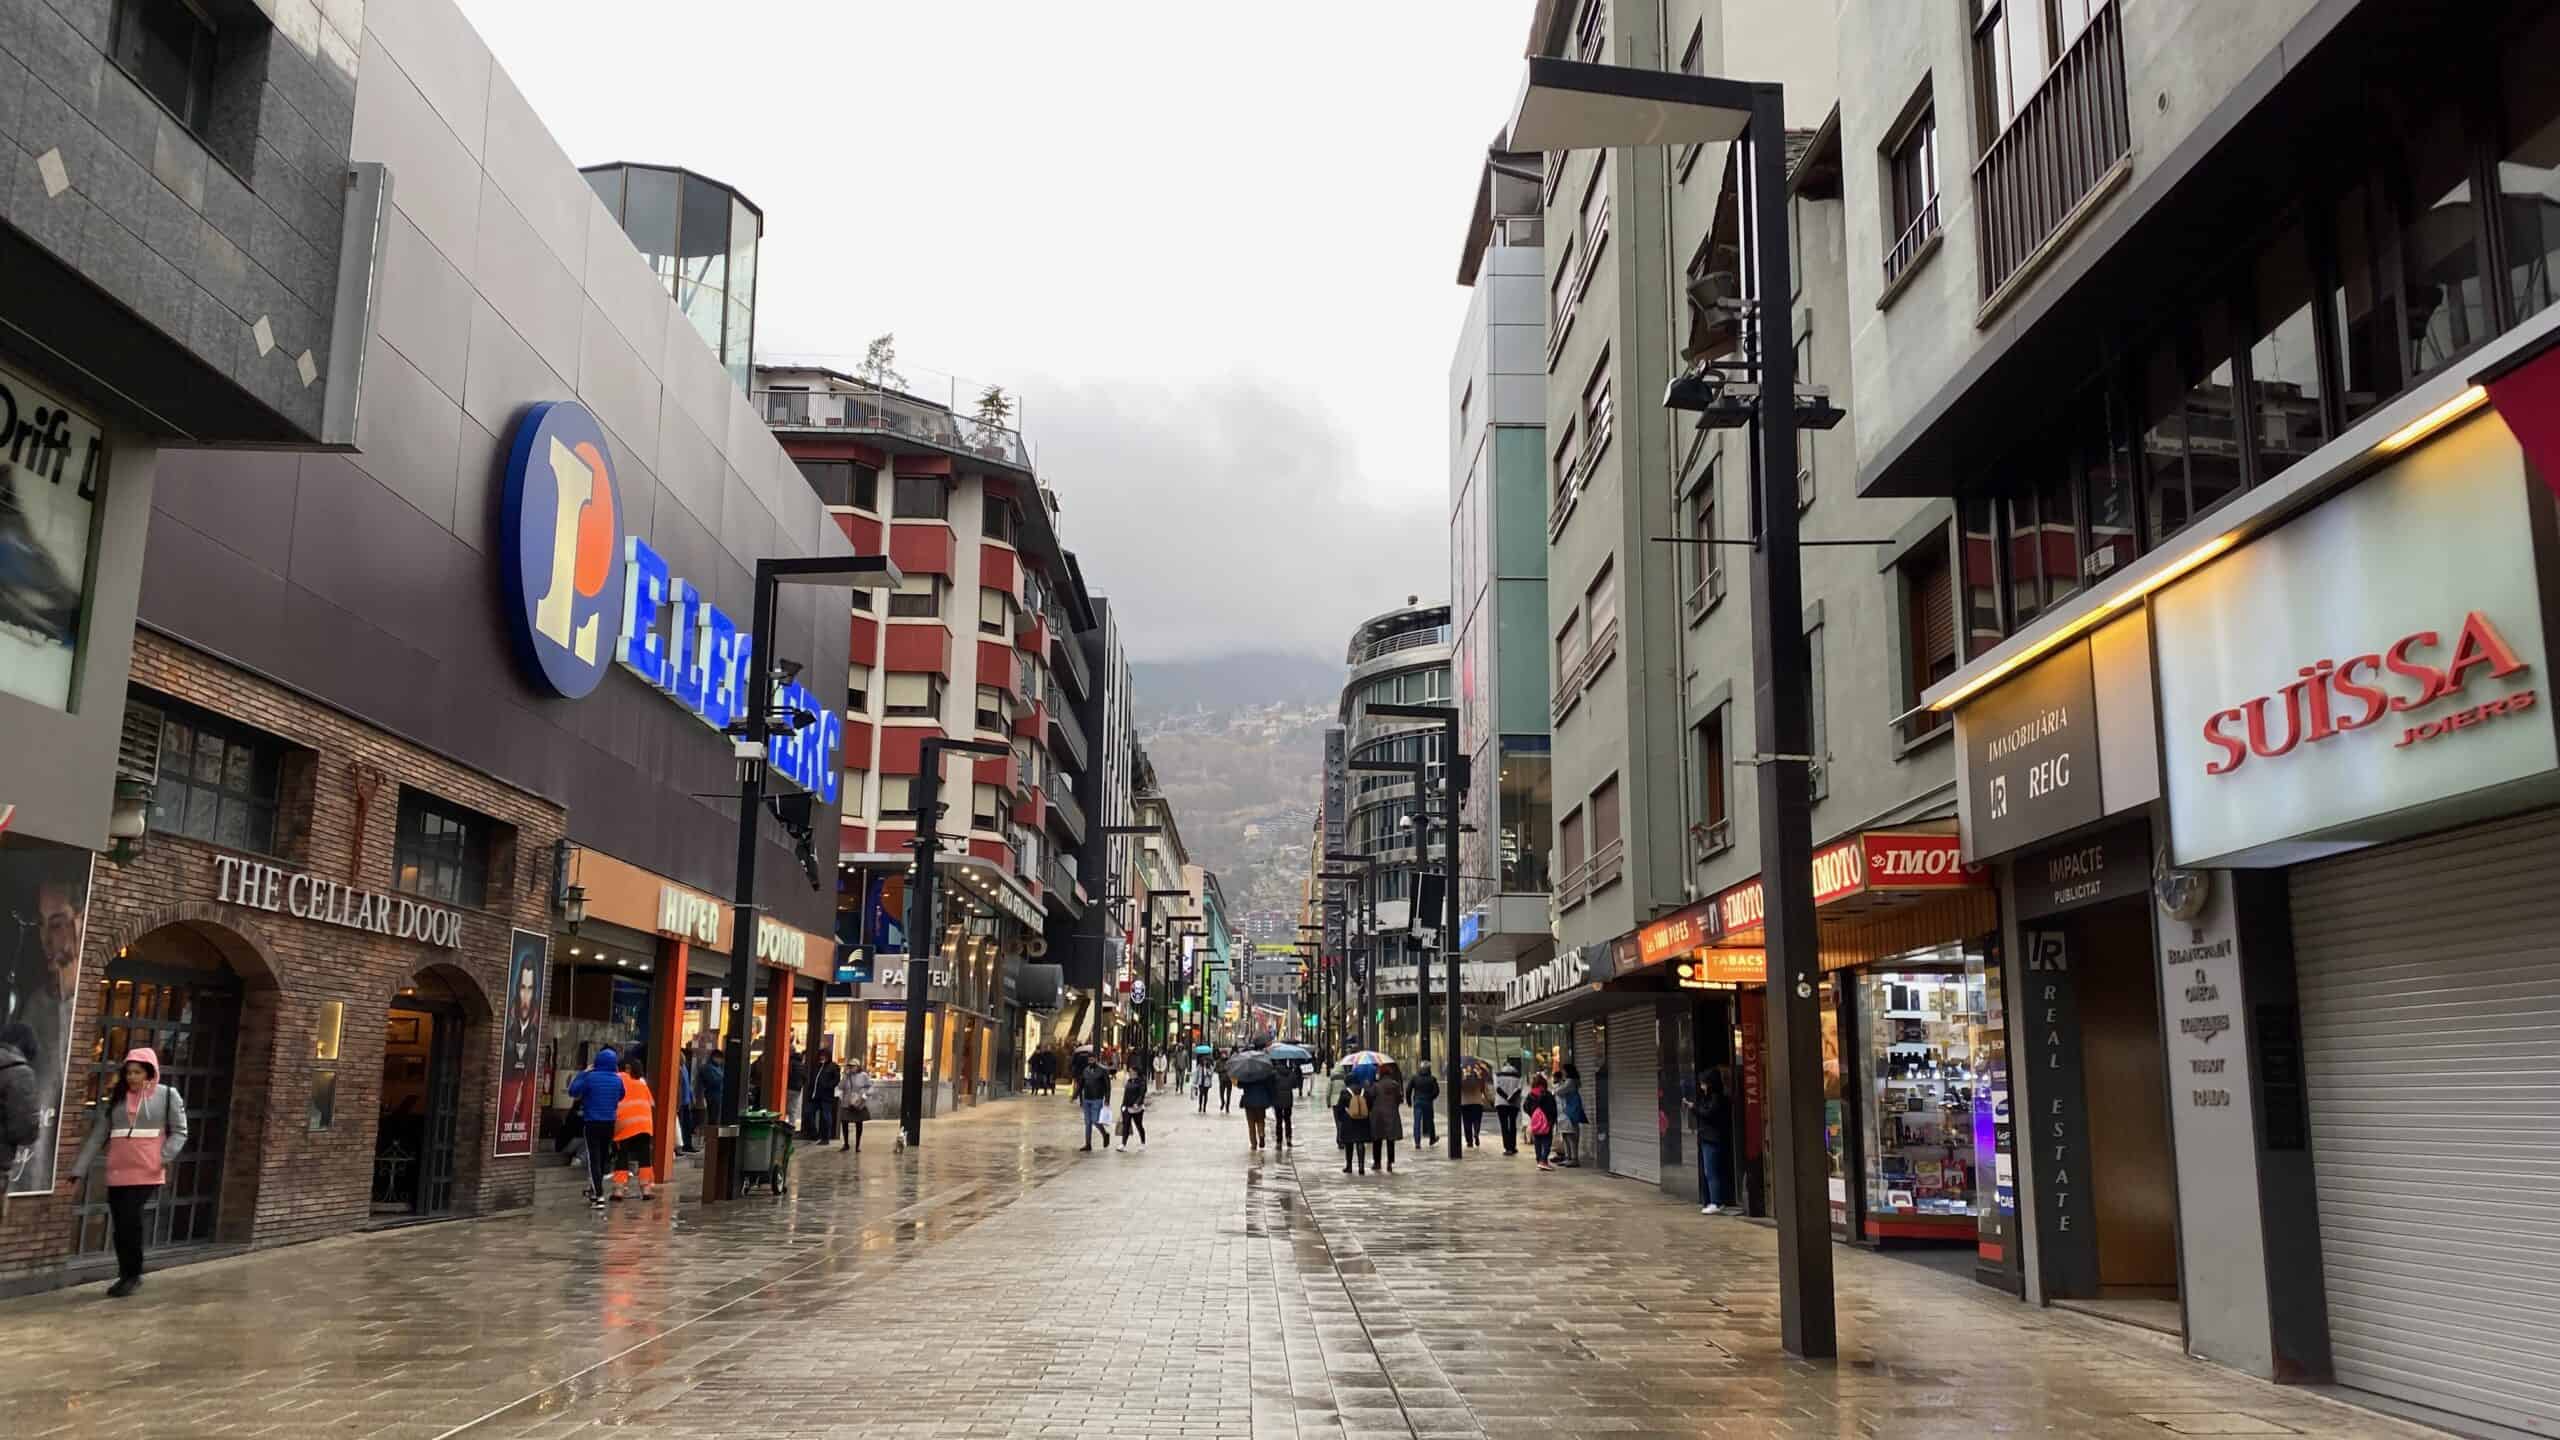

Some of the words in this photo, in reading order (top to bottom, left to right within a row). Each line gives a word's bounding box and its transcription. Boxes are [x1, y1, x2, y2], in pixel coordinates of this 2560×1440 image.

[2203, 608, 2531, 776] SUÏSSA
[2394, 690, 2536, 748] JOIERS
[1989, 706, 2068, 763] IMMOBILIÀRIA
[2029, 752, 2070, 800] REIG
[1813, 844, 1862, 896] IMOTO
[1883, 849, 1984, 874] IMOT
[2049, 847, 2103, 883] IMPACTE
[215, 855, 282, 912] THE
[288, 873, 392, 935] CELLAR
[397, 899, 463, 950] DOOR
[657, 885, 720, 945] HIPER
[1727, 885, 1764, 928] IMOTO
[2054, 880, 2101, 905] PUBLICITAT
[1712, 954, 1763, 967] TABACS
[1744, 1042, 1760, 1104] TABACS
[2044, 985, 2060, 1069] REAL
[2052, 1098, 2072, 1232] ESTATE
